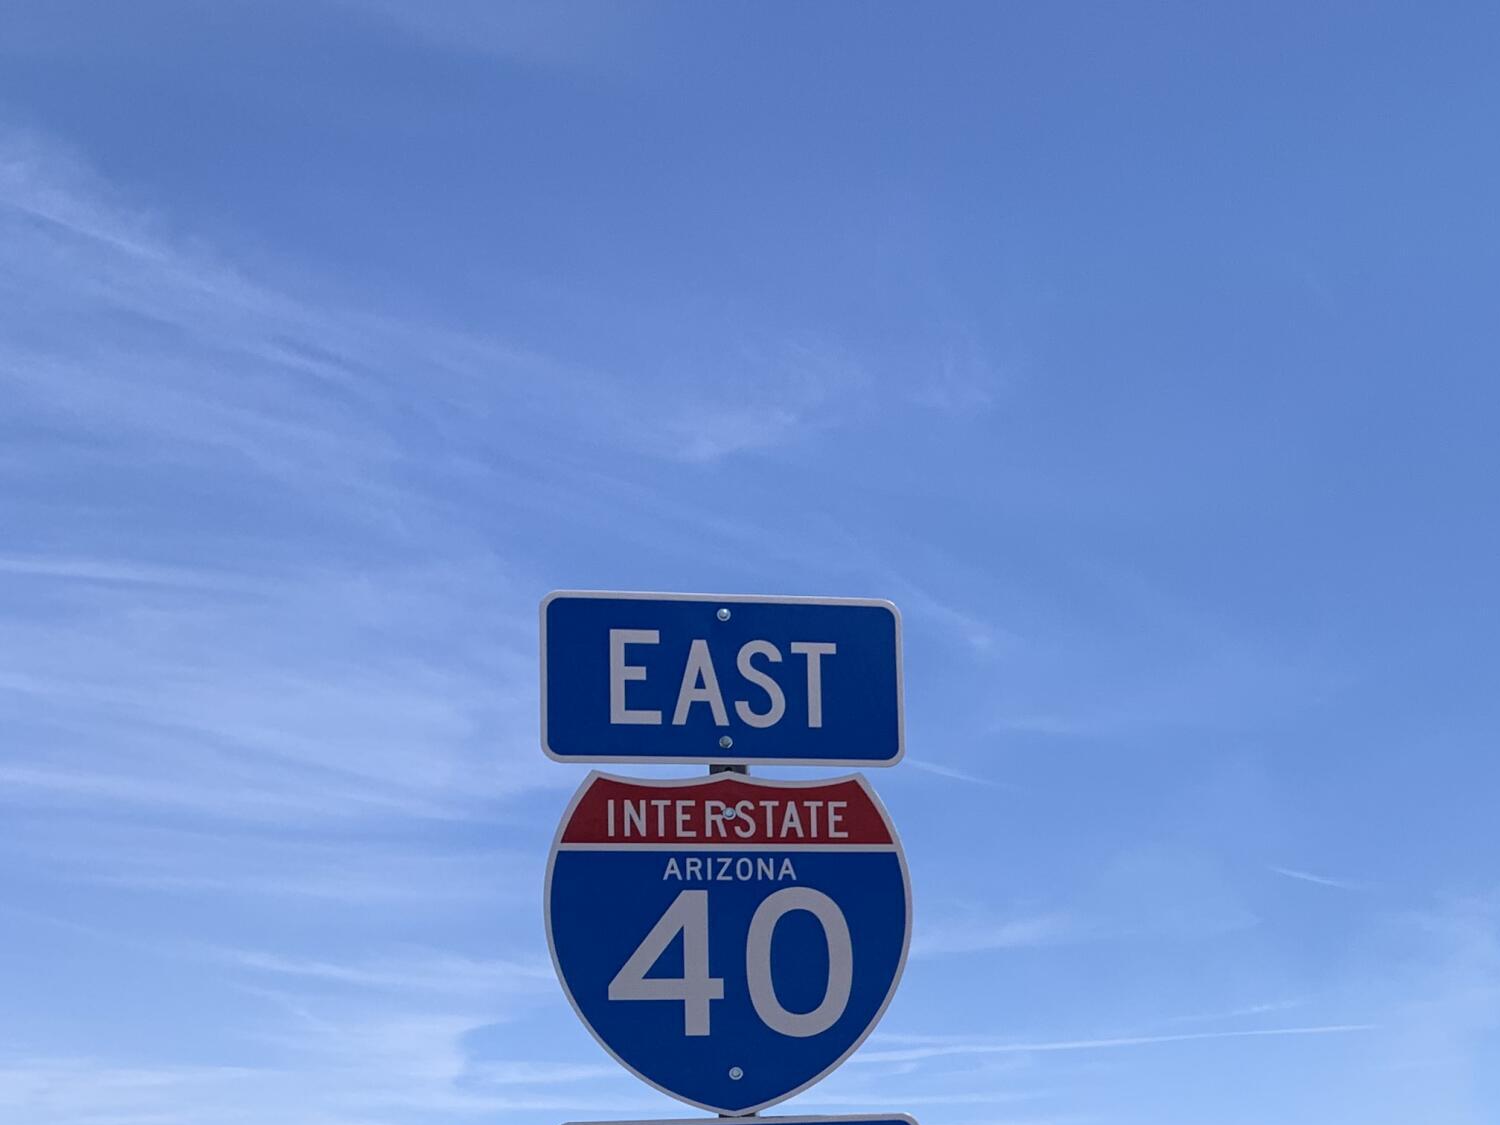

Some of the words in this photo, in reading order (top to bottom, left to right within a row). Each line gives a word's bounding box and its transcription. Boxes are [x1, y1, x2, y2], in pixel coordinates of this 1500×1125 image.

[609, 629, 837, 728] EAST
[607, 800, 848, 838] INTERSTATE
[663, 858, 797, 881] ARIZONA
[607, 887, 853, 1037] 40
